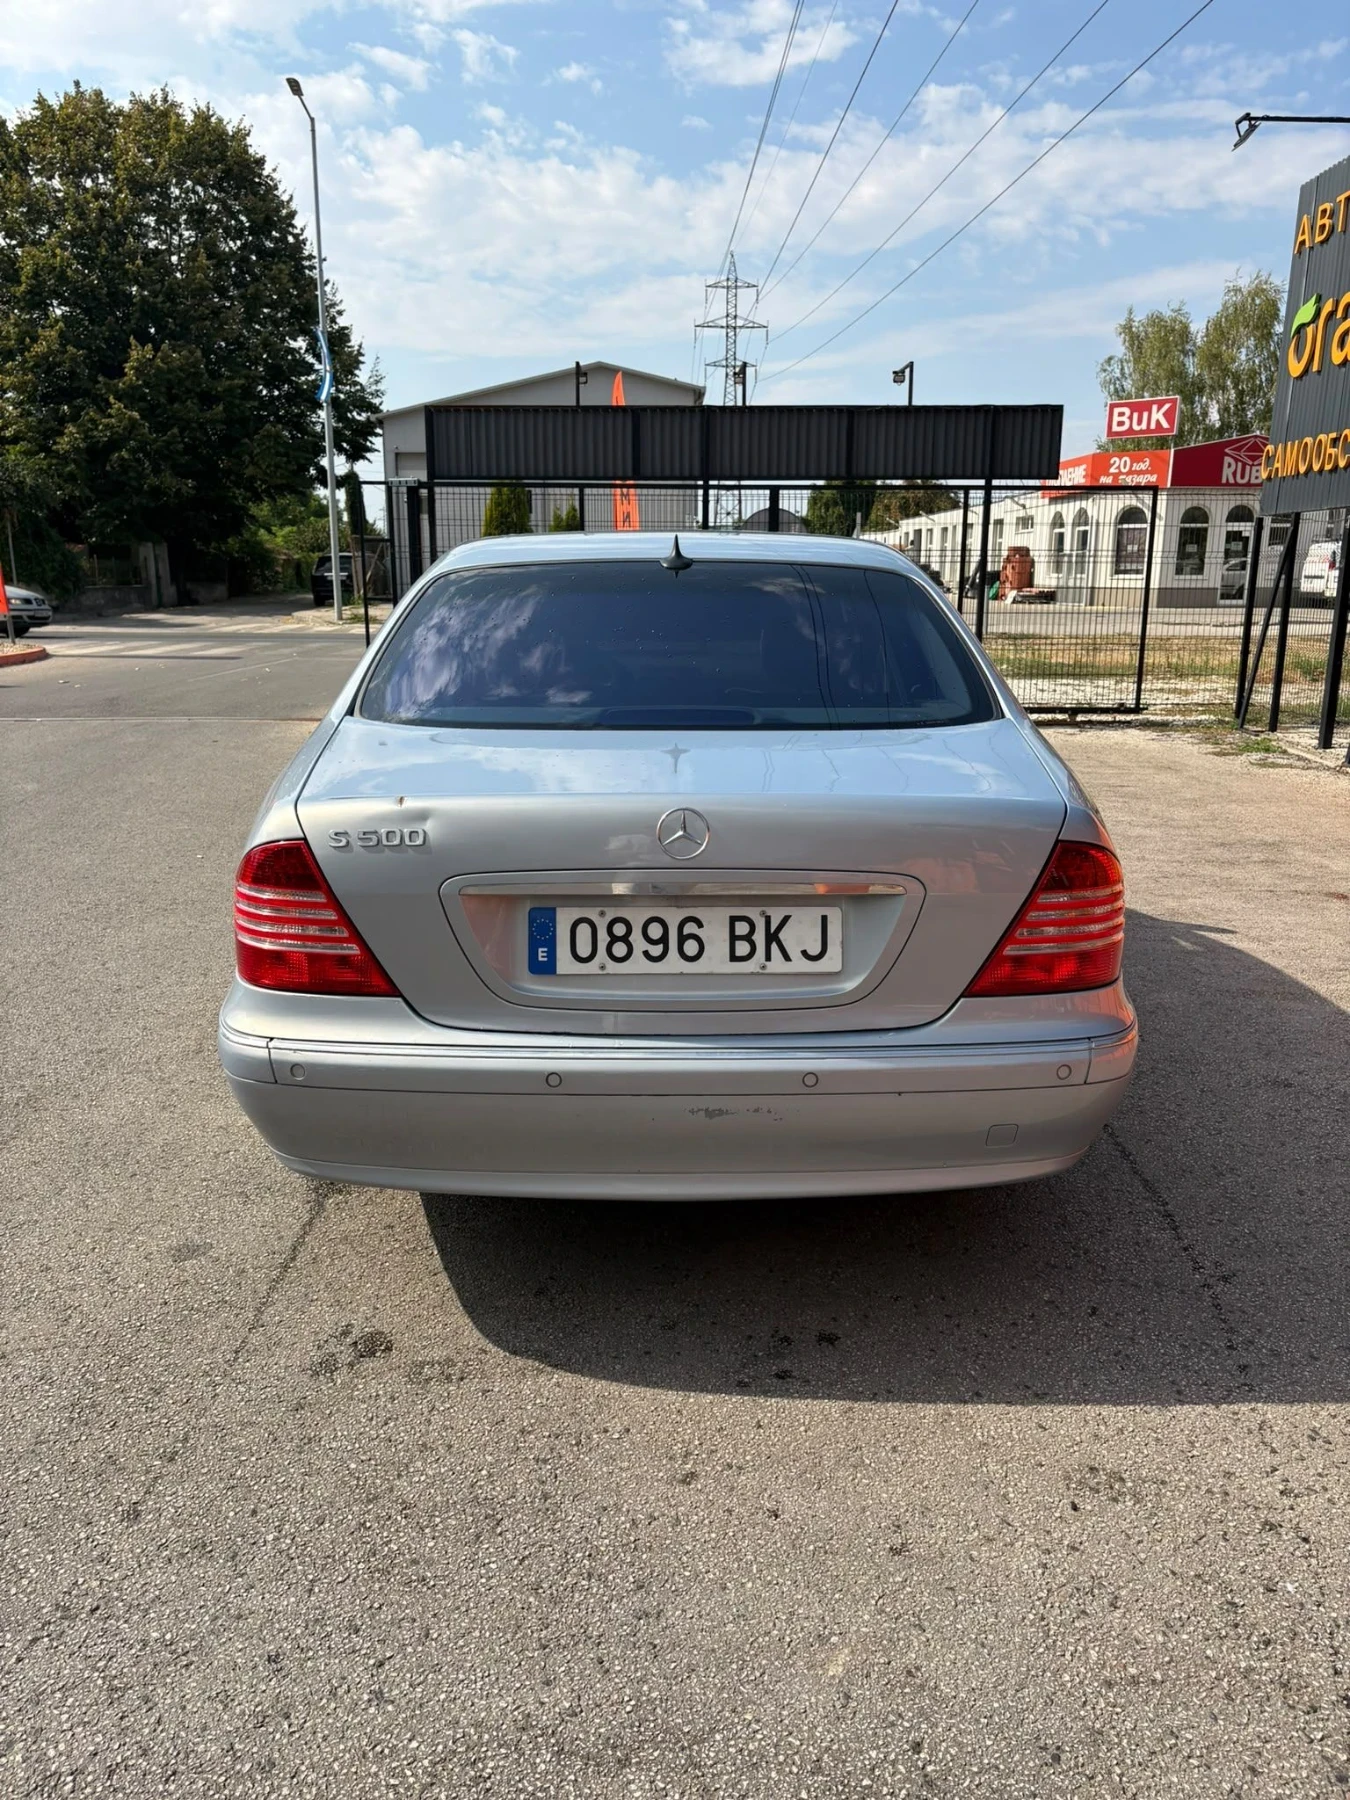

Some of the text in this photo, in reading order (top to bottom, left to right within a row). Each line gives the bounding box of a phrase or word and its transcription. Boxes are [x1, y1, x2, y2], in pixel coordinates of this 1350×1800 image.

[1109, 456, 1131, 473] 20
[328, 828, 427, 848] S 500
[569, 914, 829, 964] 0896 BKJ
[537, 947, 548, 961] E
